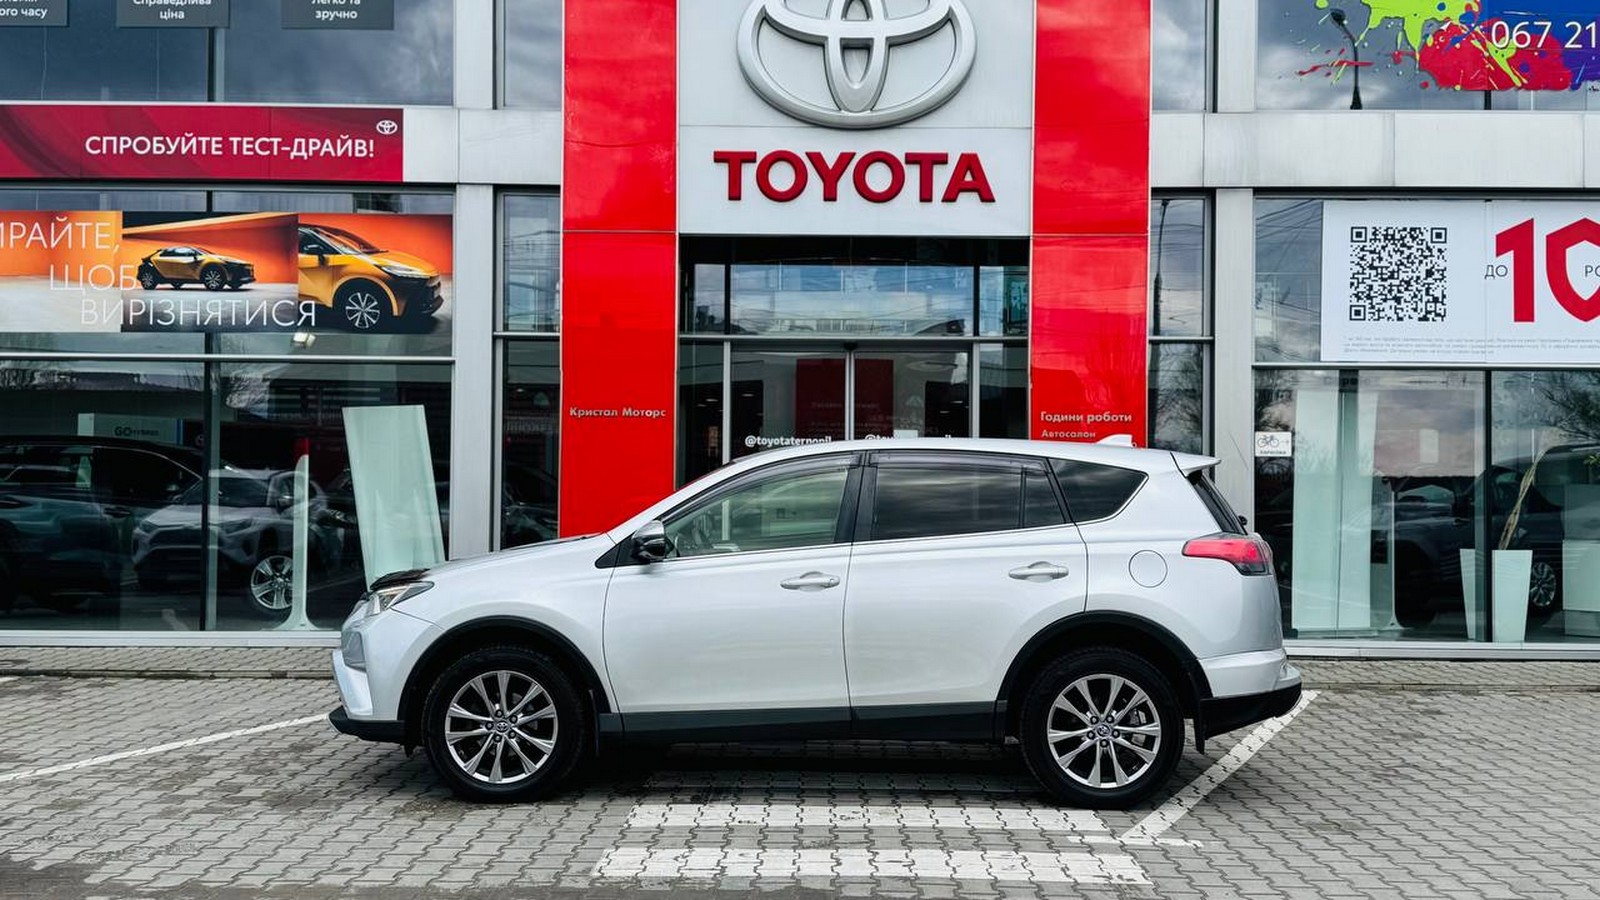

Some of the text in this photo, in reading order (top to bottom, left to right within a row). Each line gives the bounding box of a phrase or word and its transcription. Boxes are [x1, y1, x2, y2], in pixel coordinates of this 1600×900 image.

[20, 8, 48, 19] часу
[159, 8, 185, 20] ціна
[315, 10, 358, 21] зручно
[1491, 21, 1552, 48] 067
[85, 133, 375, 160] СПРОБУЙТЕ ТЕСТ-ДРАЙВ!
[713, 150, 996, 203] TOYOTA
[0, 216, 120, 252] РАЙТЕ,
[50, 264, 137, 295] ЩОБ
[1484, 265, 1508, 280] ДО
[81, 299, 316, 327] ВИРІЗНЯТИСЯ
[569, 407, 667, 418] Кристал Моторс
[1040, 411, 1132, 424] Години роботи
[1042, 429, 1096, 438] Автосалон
